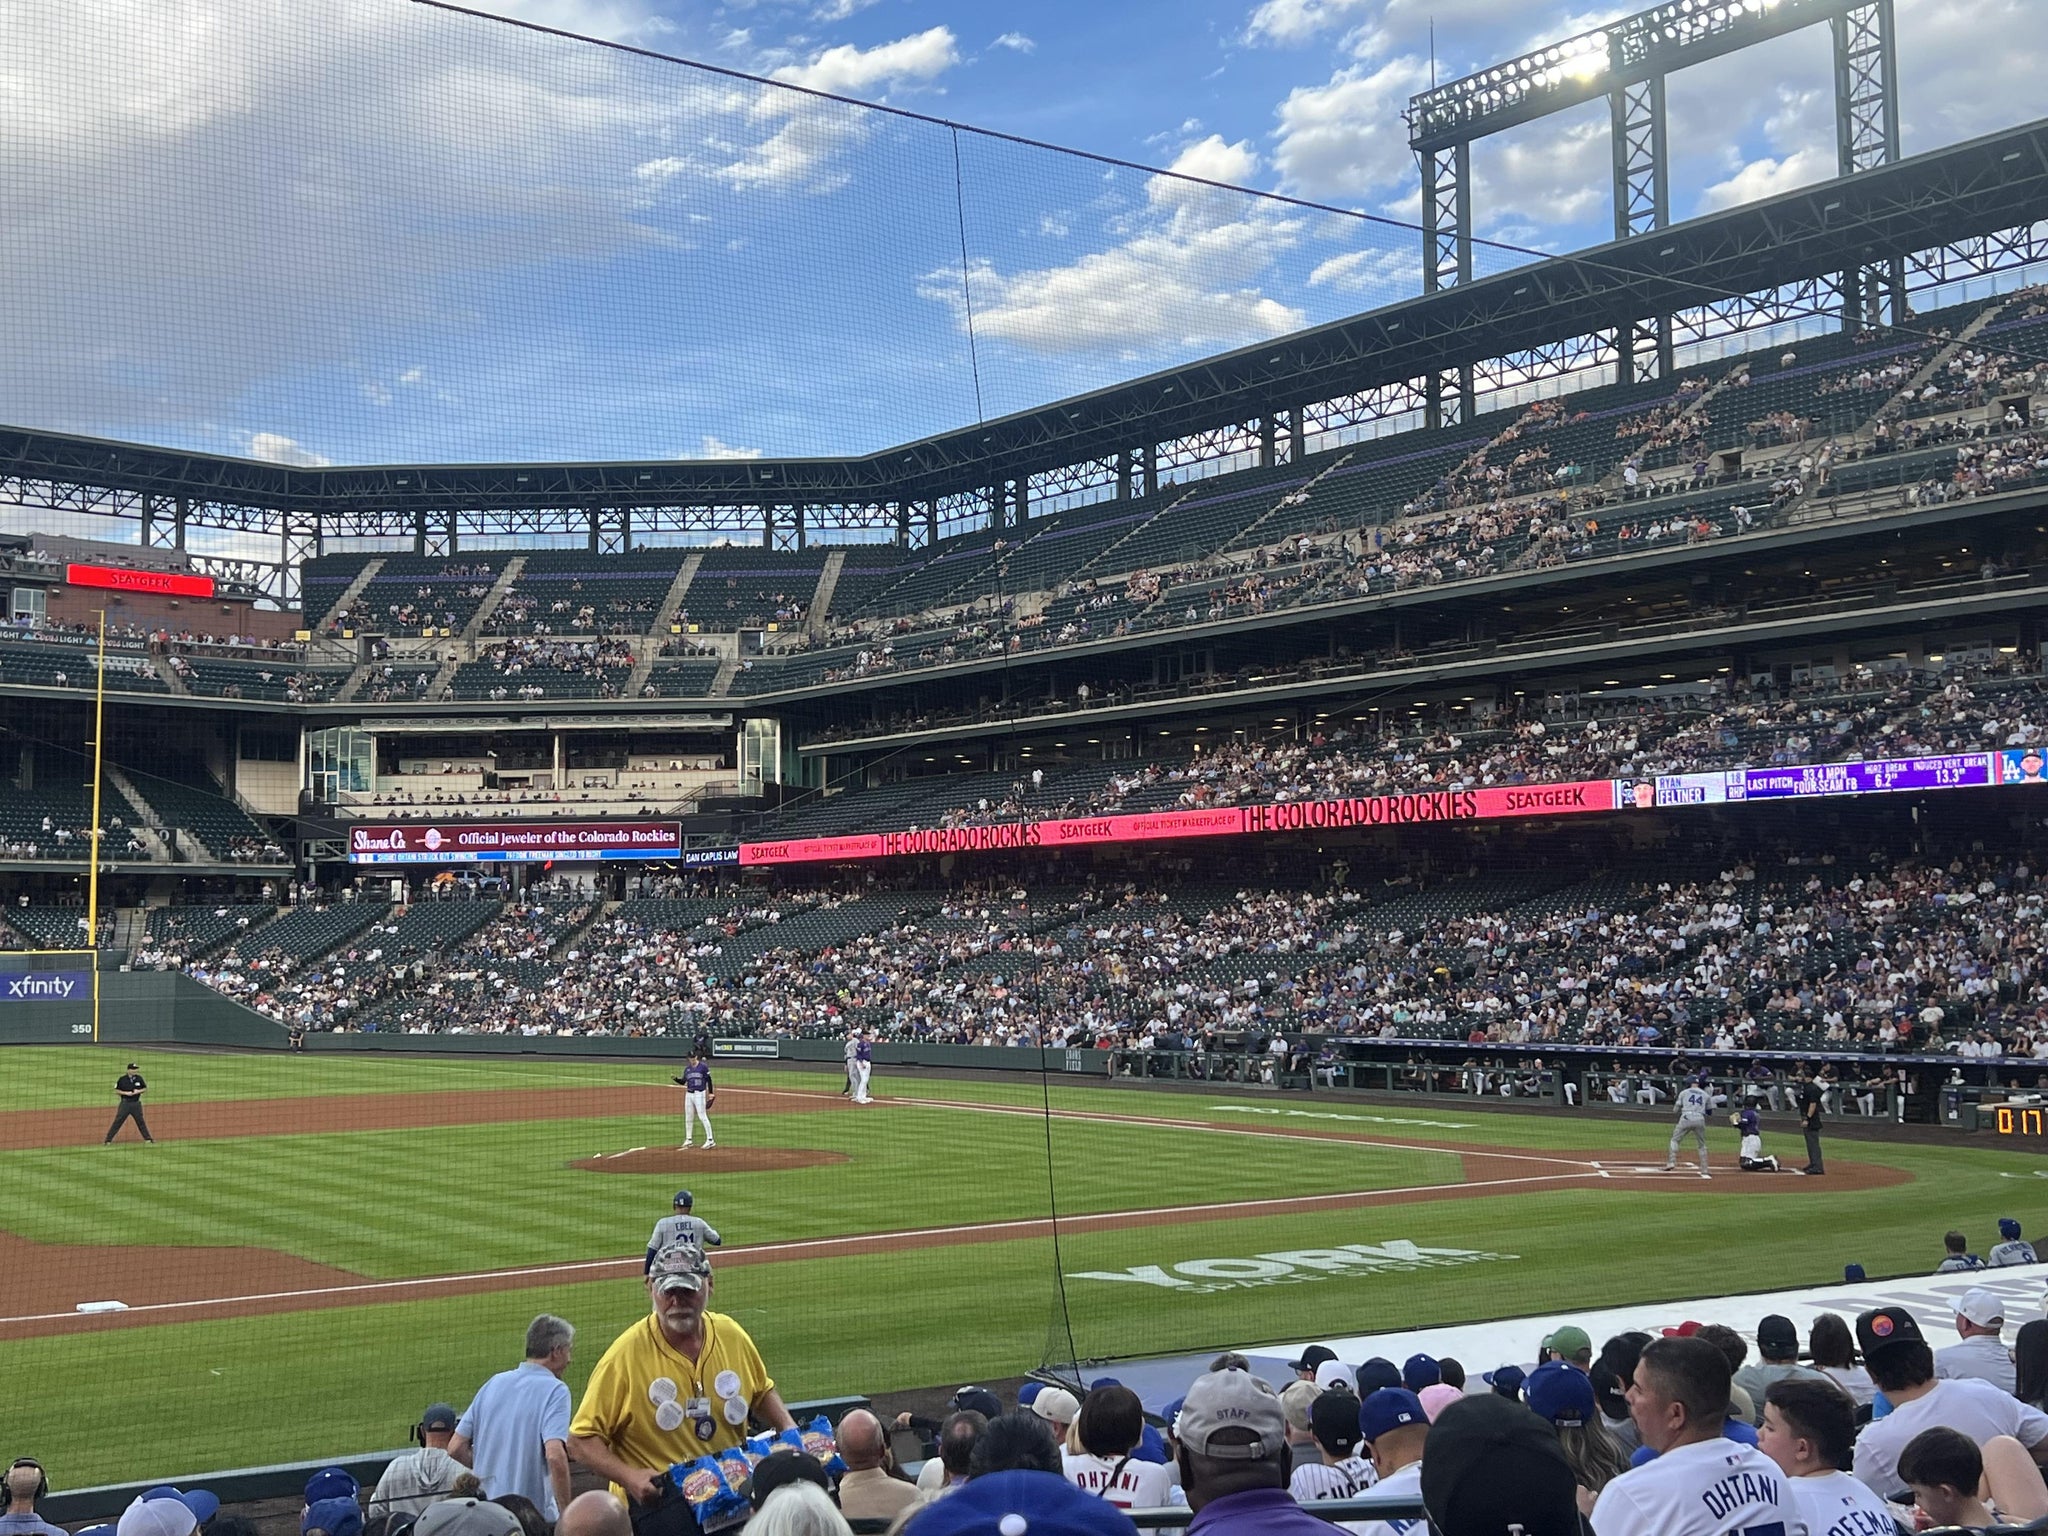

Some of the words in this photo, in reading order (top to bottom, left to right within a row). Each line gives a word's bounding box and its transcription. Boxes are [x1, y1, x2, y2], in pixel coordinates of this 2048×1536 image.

[111, 572, 171, 590] SEATGEEK
[60, 636, 83, 644] LIGHT
[122, 640, 145, 650] LIGHT
[1913, 758, 1943, 771] INDUCED
[1963, 756, 1988, 767] BREAK
[1730, 772, 1741, 784] 18
[1803, 767, 1824, 781] 93.4
[1826, 766, 1848, 780] MPH
[1659, 777, 1682, 789] RYAN
[1748, 778, 1768, 791] LAST
[1769, 776, 1793, 789] PITCH
[1794, 778, 1844, 794] FOUR-SEAM
[1846, 777, 1858, 790] FB
[1506, 786, 1586, 811] SEATGEEK
[1660, 787, 1702, 805] FELTNER
[1728, 785, 1744, 799] RHP
[1239, 805, 1271, 833] THE
[1274, 798, 1383, 829] COLORADO
[1386, 790, 1477, 824] ROCKIES
[1228, 814, 1236, 826] OF
[458, 831, 499, 845] Official
[500, 831, 542, 846] Jeweler
[544, 831, 557, 844] of
[558, 830, 576, 843] the
[578, 829, 630, 843] Colorado
[632, 829, 676, 843] Rockies
[1060, 820, 1113, 840] SEATGEEK
[354, 830, 390, 850] Shane
[879, 832, 901, 855] THE
[903, 827, 977, 854] COLORADO
[981, 822, 1041, 850] ROCKIES
[686, 851, 699, 863] DAN
[724, 849, 739, 860] LAW
[751, 844, 790, 860] SEATGEEK
[9, 975, 75, 998] xfinity
[71, 1024, 92, 1034] 350
[1688, 1094, 1703, 1106] 44
[675, 1221, 694, 1232] EBEL
[1065, 1239, 1484, 1287] YORK
[1176, 1271, 1327, 1294] SPACE
[1327, 1251, 1522, 1277] SYSTEMS
[1216, 1407, 1251, 1421] STAFF
[1702, 1473, 1779, 1521] OHTANI
